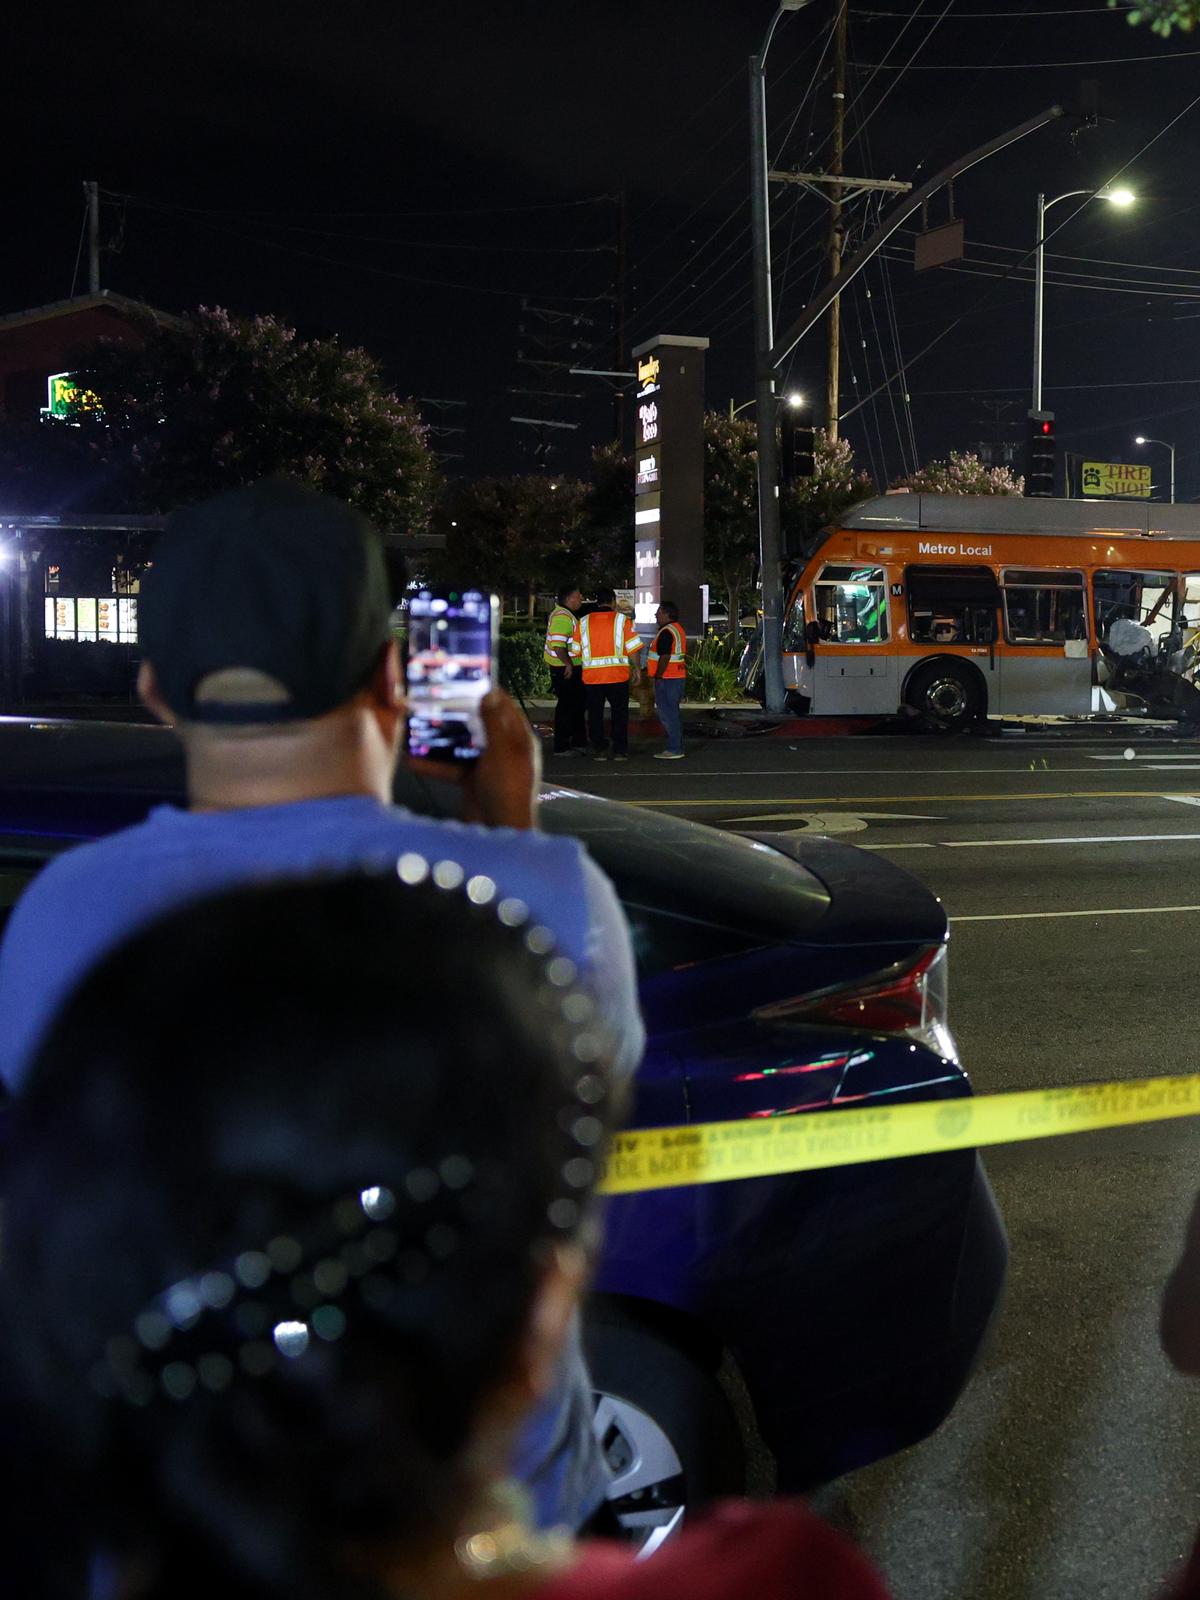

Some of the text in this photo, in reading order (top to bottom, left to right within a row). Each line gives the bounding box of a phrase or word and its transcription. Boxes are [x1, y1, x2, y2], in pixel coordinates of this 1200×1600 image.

[1105, 464, 1149, 481] TIRE
[1104, 481, 1149, 496] SHOP
[919, 542, 956, 555] Metro
[959, 543, 992, 556] Local
